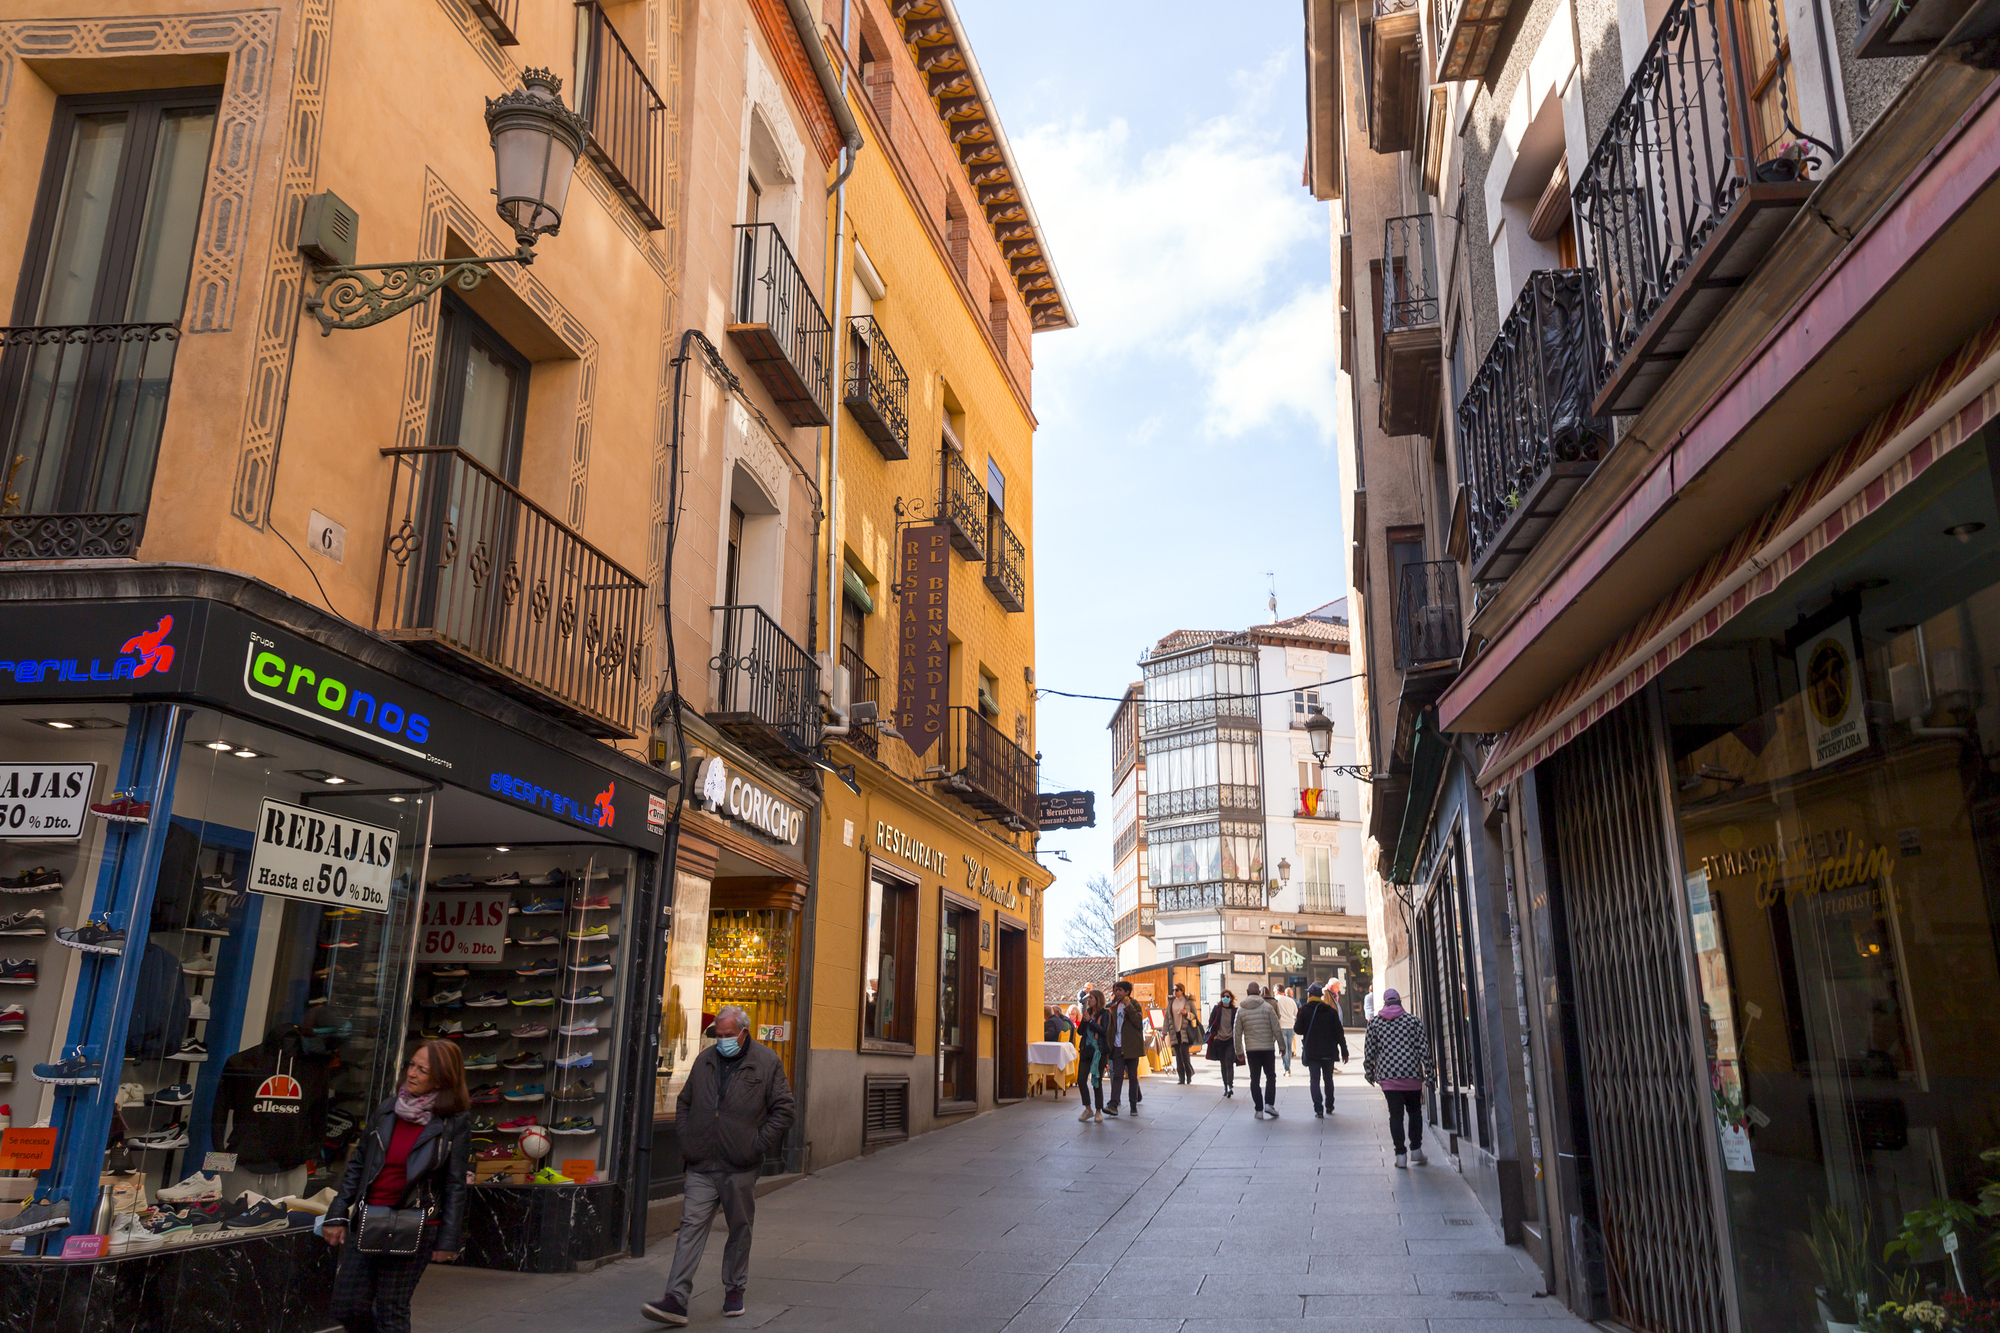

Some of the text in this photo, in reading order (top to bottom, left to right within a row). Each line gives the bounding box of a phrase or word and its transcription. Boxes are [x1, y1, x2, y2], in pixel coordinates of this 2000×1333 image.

[322, 527, 332, 549] 6
[250, 631, 275, 648] Grupo
[902, 541, 919, 727] RESTAURANTE
[924, 535, 944, 733] EL BERNARDINO
[253, 651, 430, 744] cronos
[1816, 732, 1862, 762] INTERFLORA
[0, 772, 83, 798] AJAS
[29, 816, 40, 828] %
[44, 816, 71, 828] Dto.
[730, 776, 799, 846] CORKCHO
[1039, 816, 1088, 825] staurante-Asador
[1046, 807, 1084, 817] Bernardino
[262, 808, 393, 867] REBAJAS
[877, 821, 948, 877] RESTAURANTE
[258, 863, 383, 904] Hasta el 50 % Dto.
[1825, 885, 1900, 915] FLORISTERA
[425, 930, 455, 954] 50
[458, 942, 469, 954] %
[472, 943, 497, 954] Dto.
[1319, 946, 1338, 957] BAR
[253, 1100, 300, 1114] ellesse
[9, 1137, 50, 1146] Se necesita
[10, 1151, 43, 1160] personal
